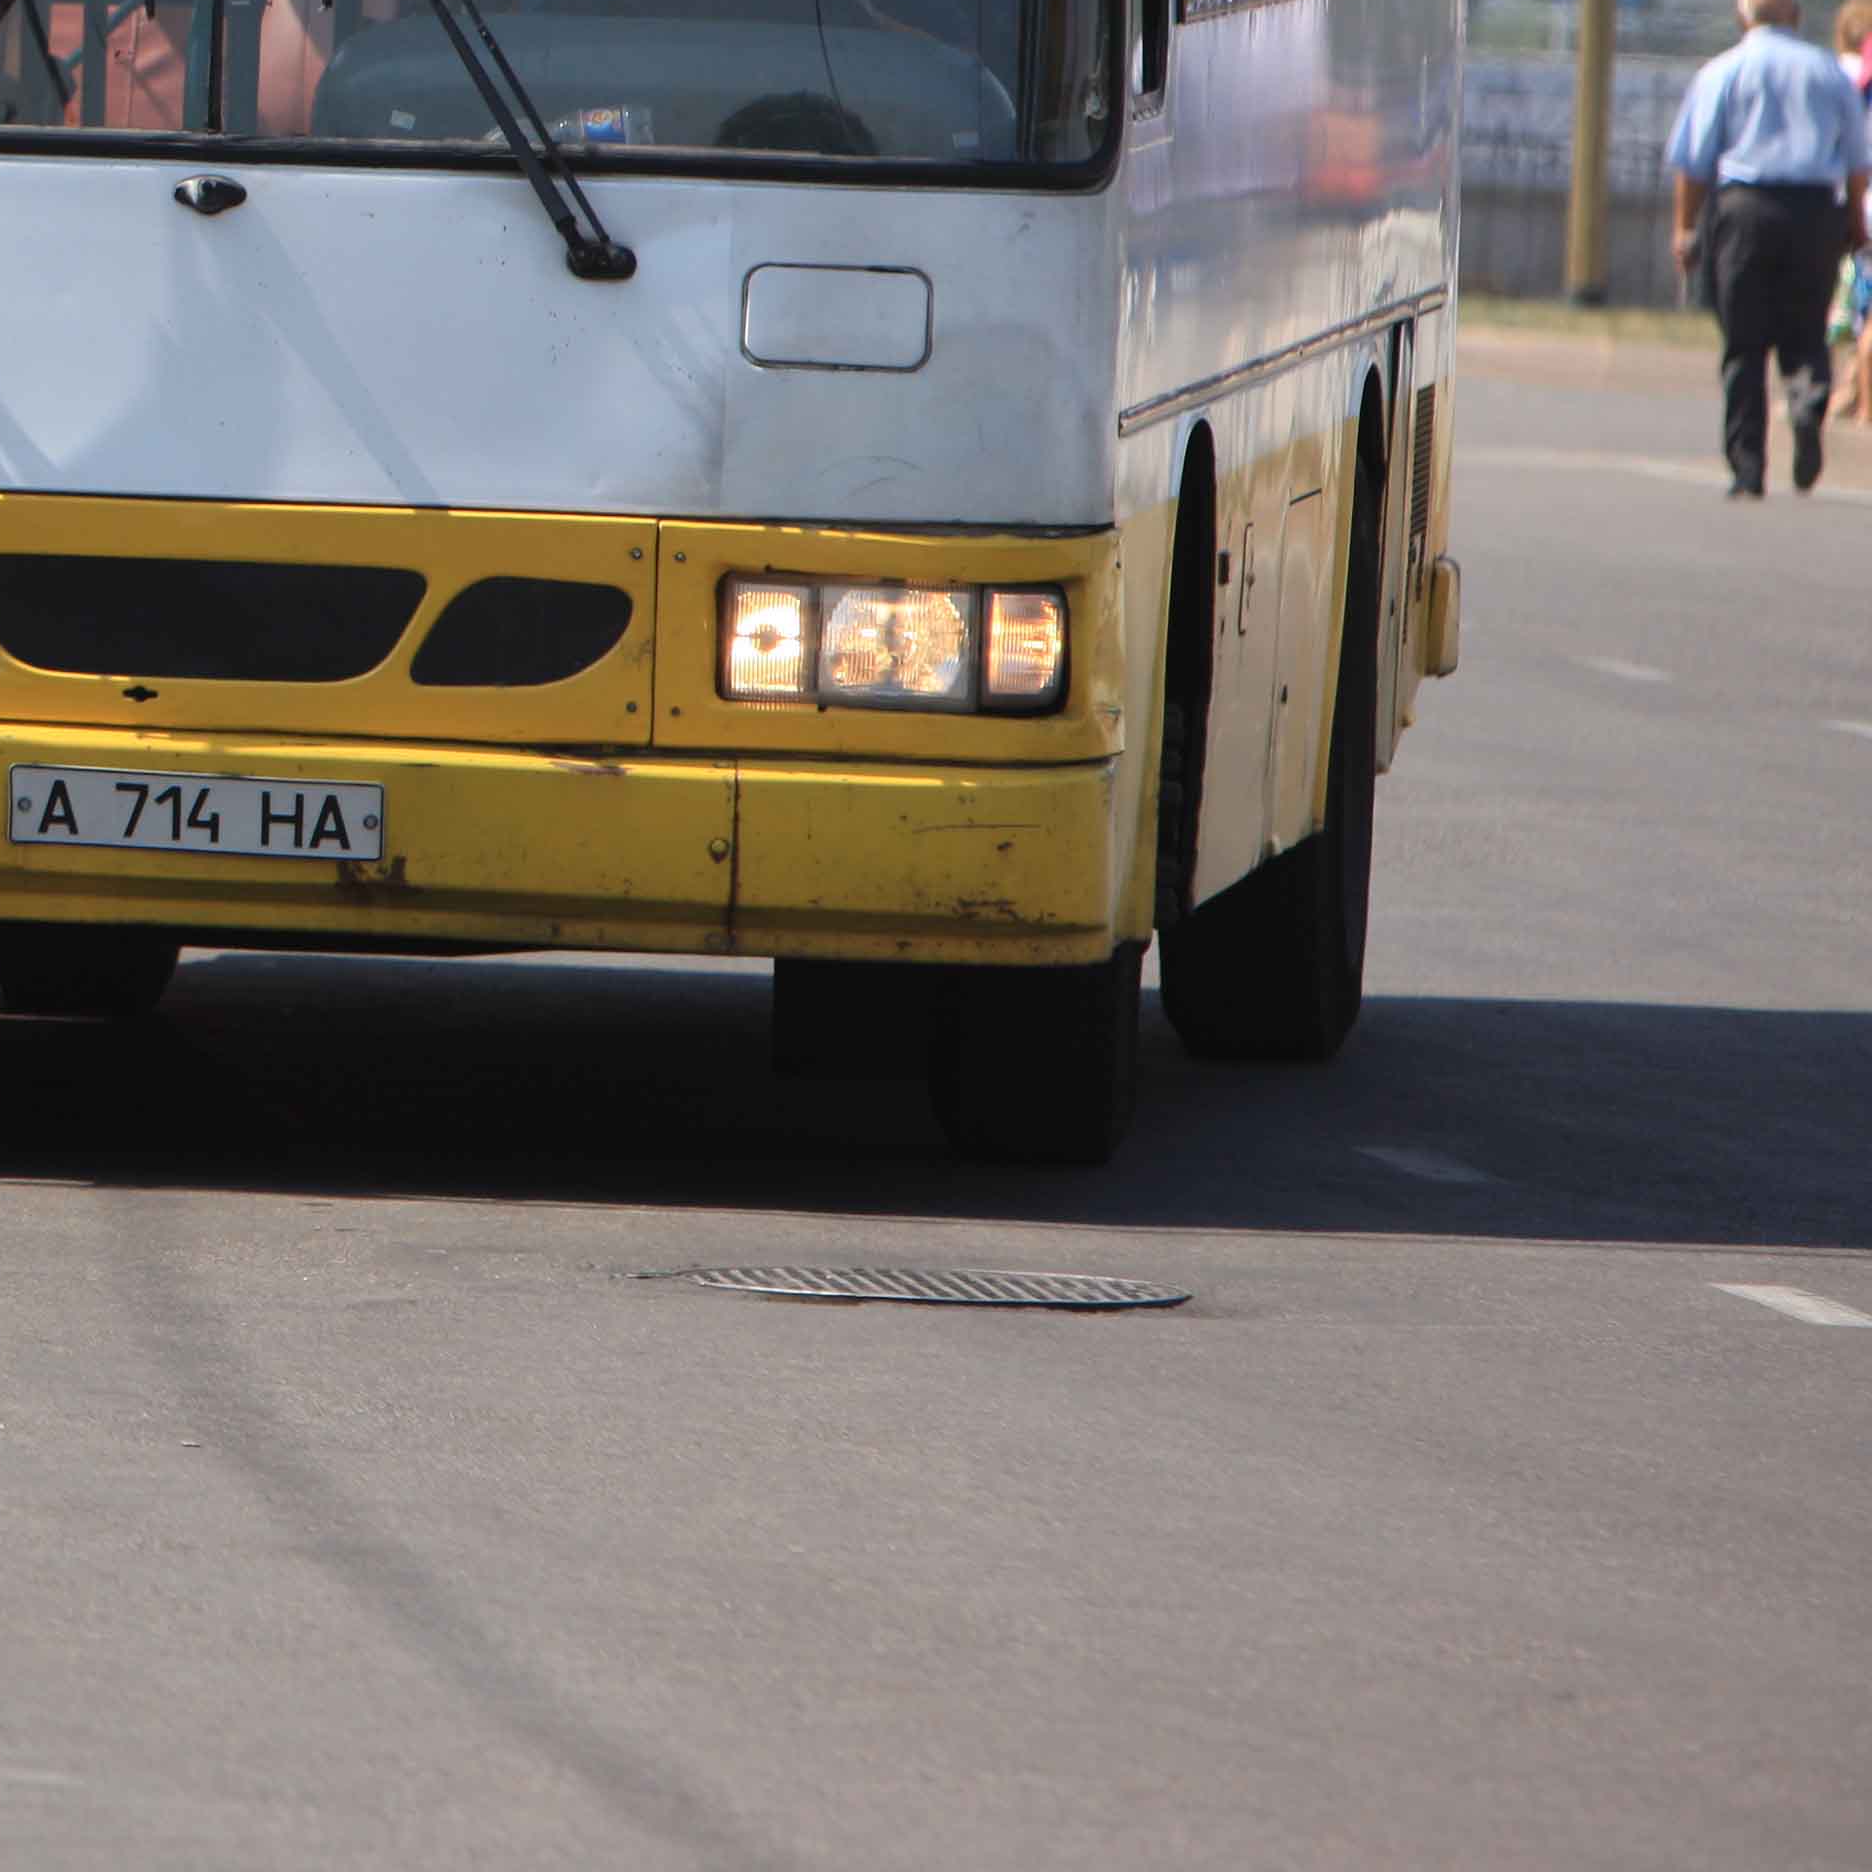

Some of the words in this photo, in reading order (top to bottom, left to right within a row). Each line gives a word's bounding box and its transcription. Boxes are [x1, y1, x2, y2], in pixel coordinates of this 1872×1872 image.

[37, 779, 78, 835] A
[115, 782, 219, 844] 714
[260, 792, 351, 850] HA
